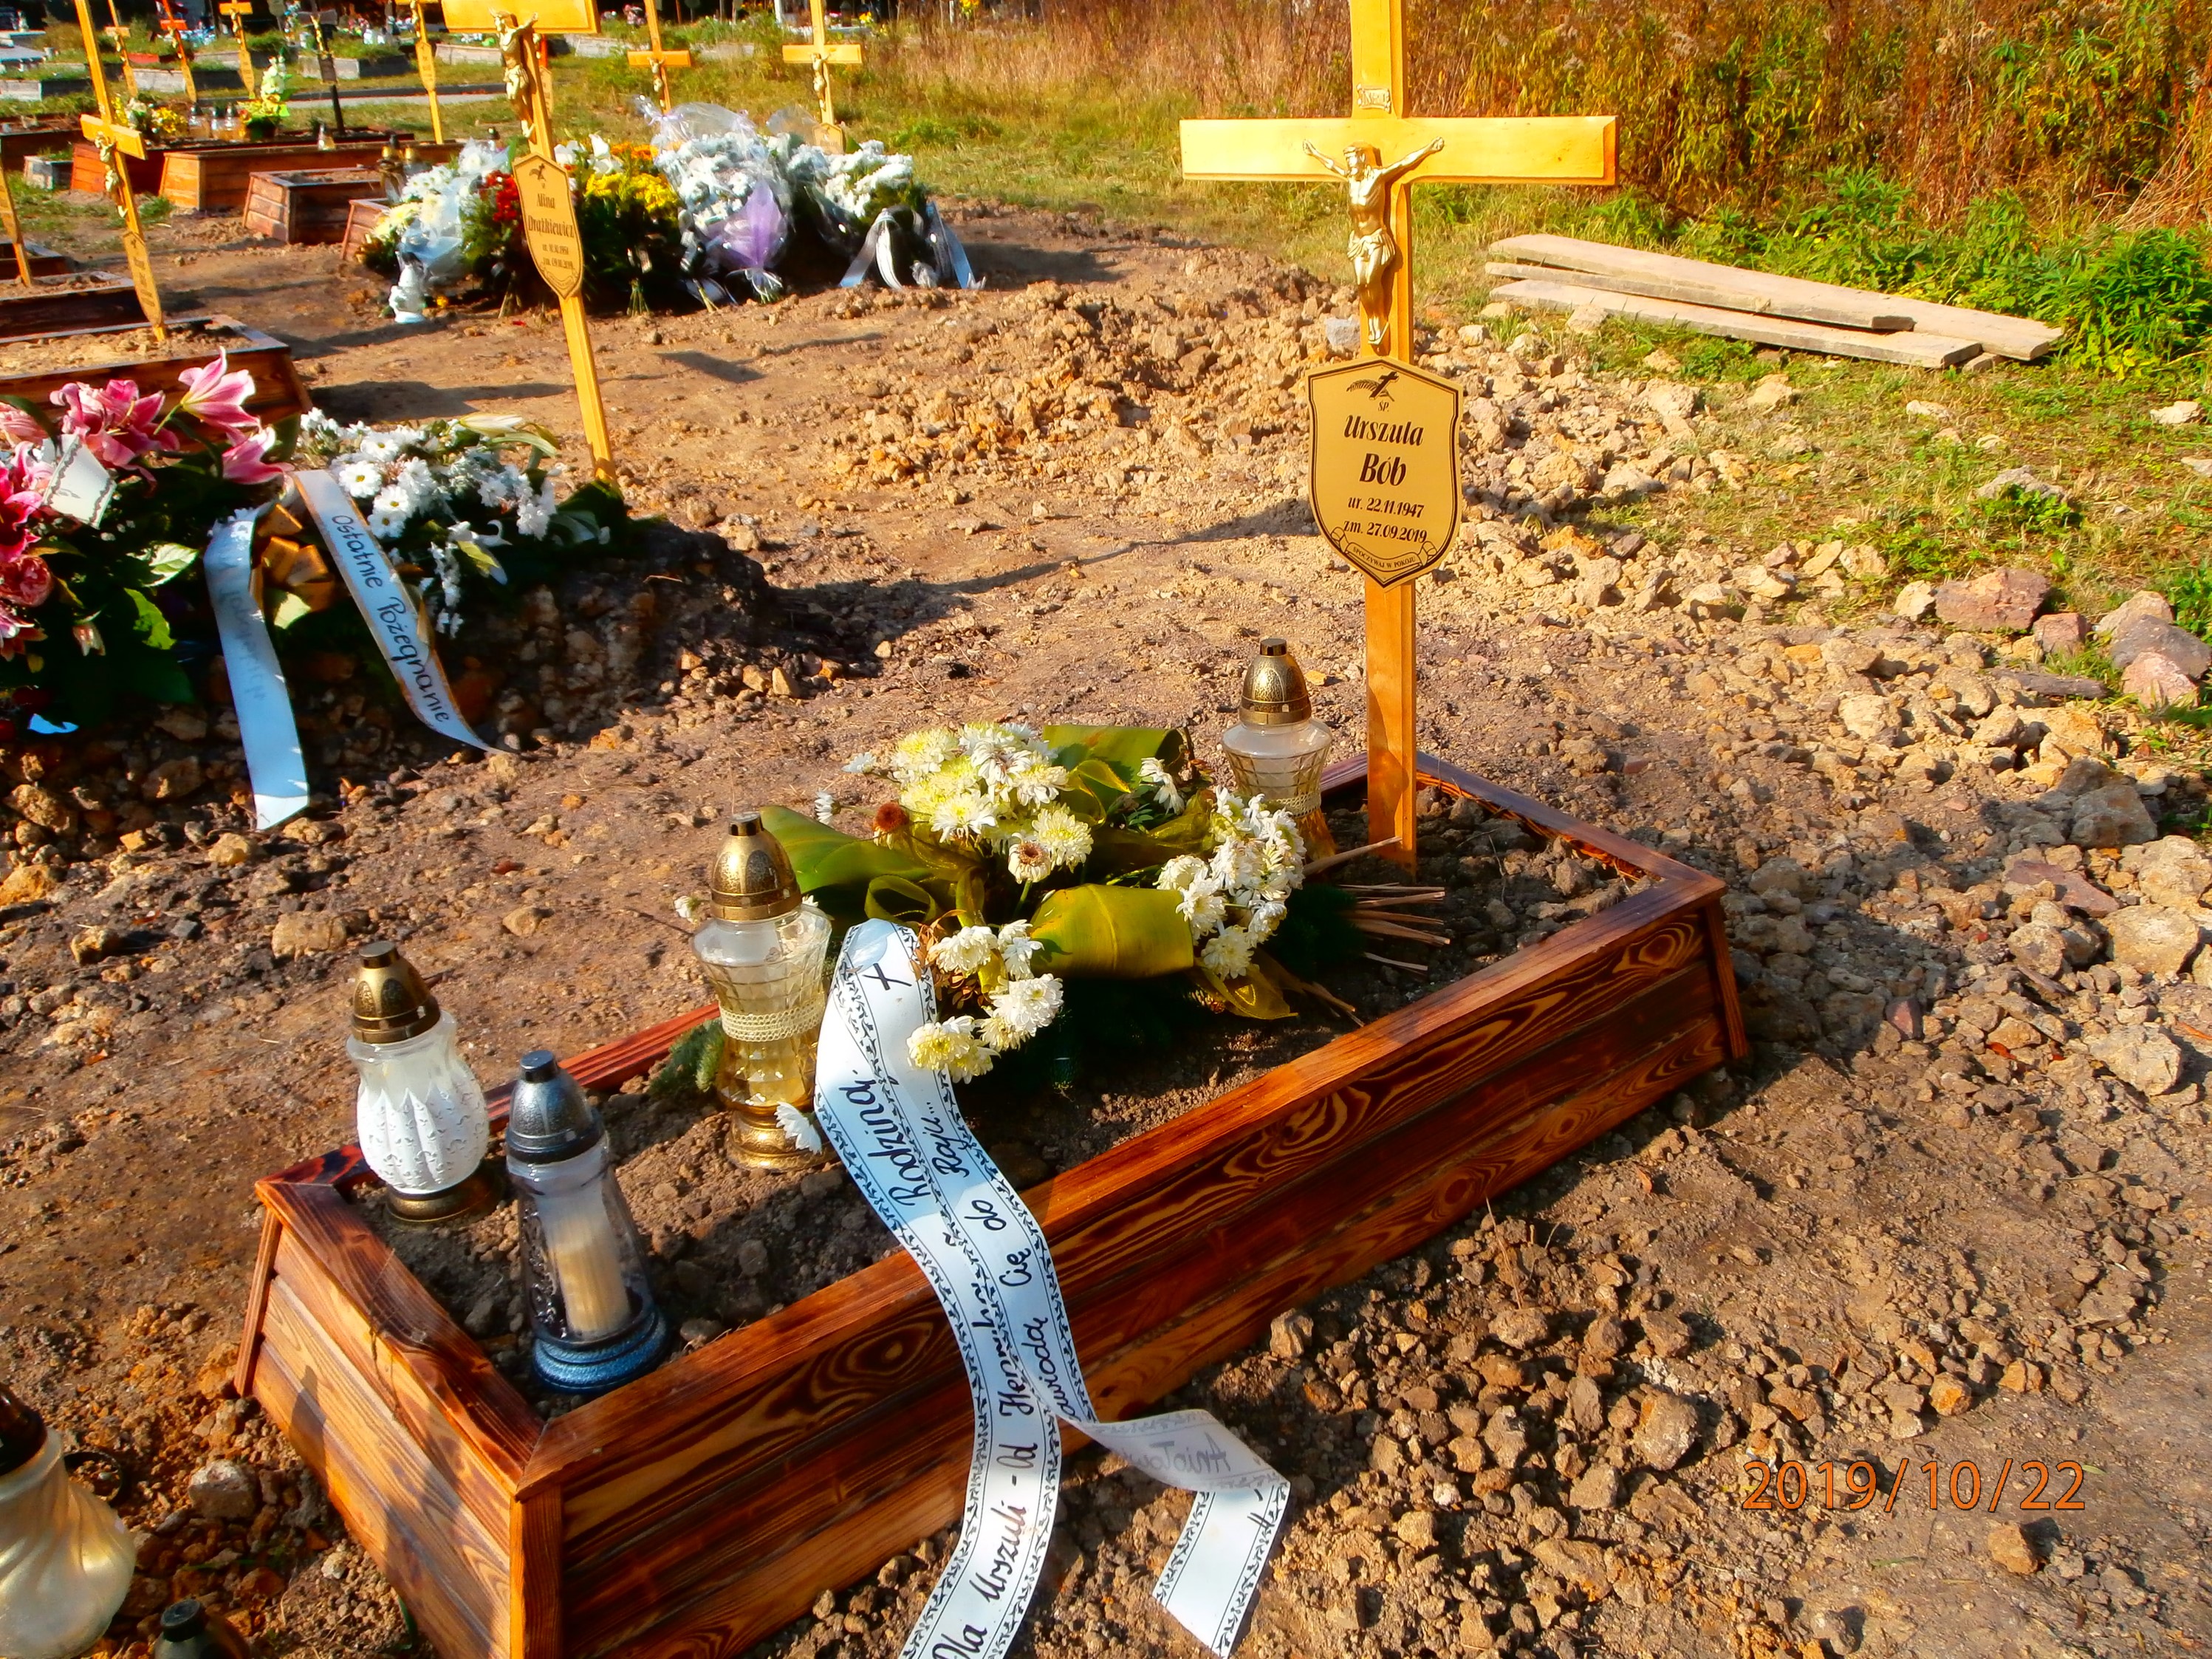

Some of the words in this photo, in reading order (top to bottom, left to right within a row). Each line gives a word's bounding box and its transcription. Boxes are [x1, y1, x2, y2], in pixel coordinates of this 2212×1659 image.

[536, 194, 555, 209] Alina
[1344, 414, 1424, 446] Urszula
[1359, 453, 1406, 486] Bób
[1348, 496, 1363, 510] ur.
[1366, 497, 1424, 519] 22.11.1947
[1343, 520, 1363, 533] zm.
[1368, 522, 1427, 543] 27.09.2019
[332, 515, 383, 589] Ostatnie
[1352, 547, 1384, 568] SPOCZYWAJ
[1394, 555, 1416, 567] POKOJU
[965, 1200, 1007, 1232] do
[999, 1247, 1033, 1287] Cię
[1022, 1316, 1081, 1422] awiodą
[996, 1443, 1038, 1469] Od
[970, 1499, 1027, 1604] Urszuli
